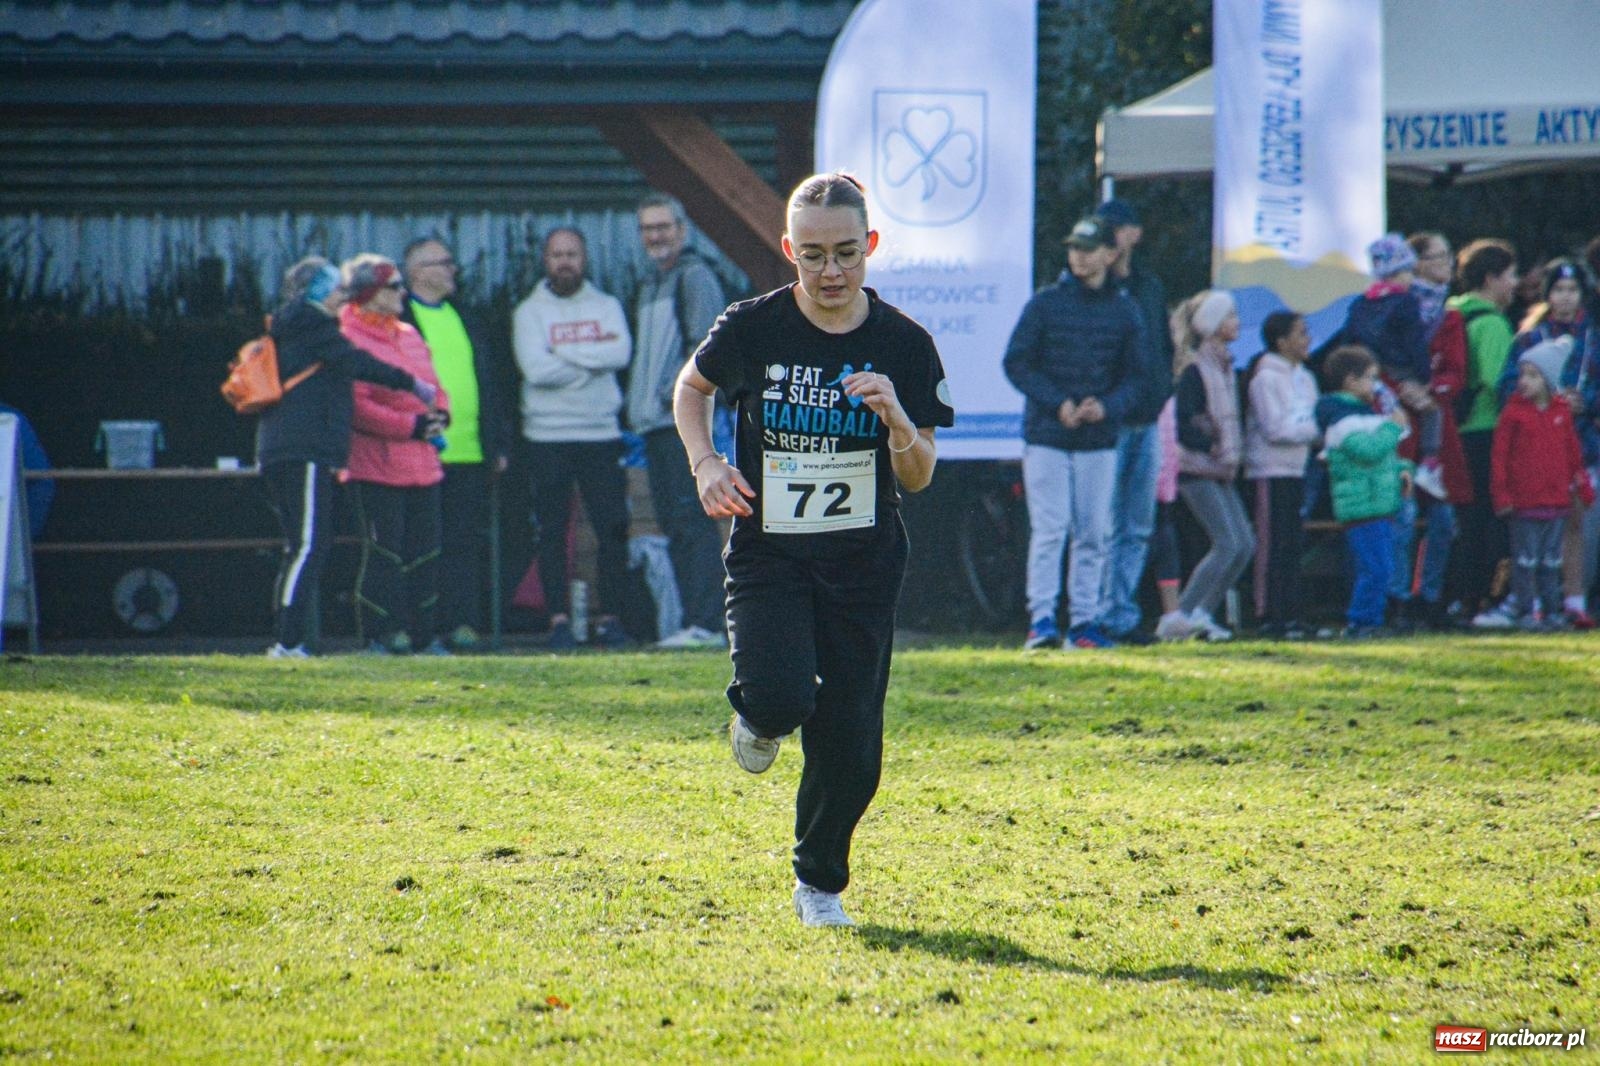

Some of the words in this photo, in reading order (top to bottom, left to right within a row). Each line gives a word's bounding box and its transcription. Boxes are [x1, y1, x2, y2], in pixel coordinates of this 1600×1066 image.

[880, 284, 1000, 305] ETROWICE
[792, 364, 823, 387] EAT
[788, 384, 841, 409] SLEEP
[763, 401, 880, 438] HANDBALL
[779, 432, 840, 454] REPEAT
[802, 459, 872, 471] www.personalbest.pl
[787, 482, 852, 519] 72
